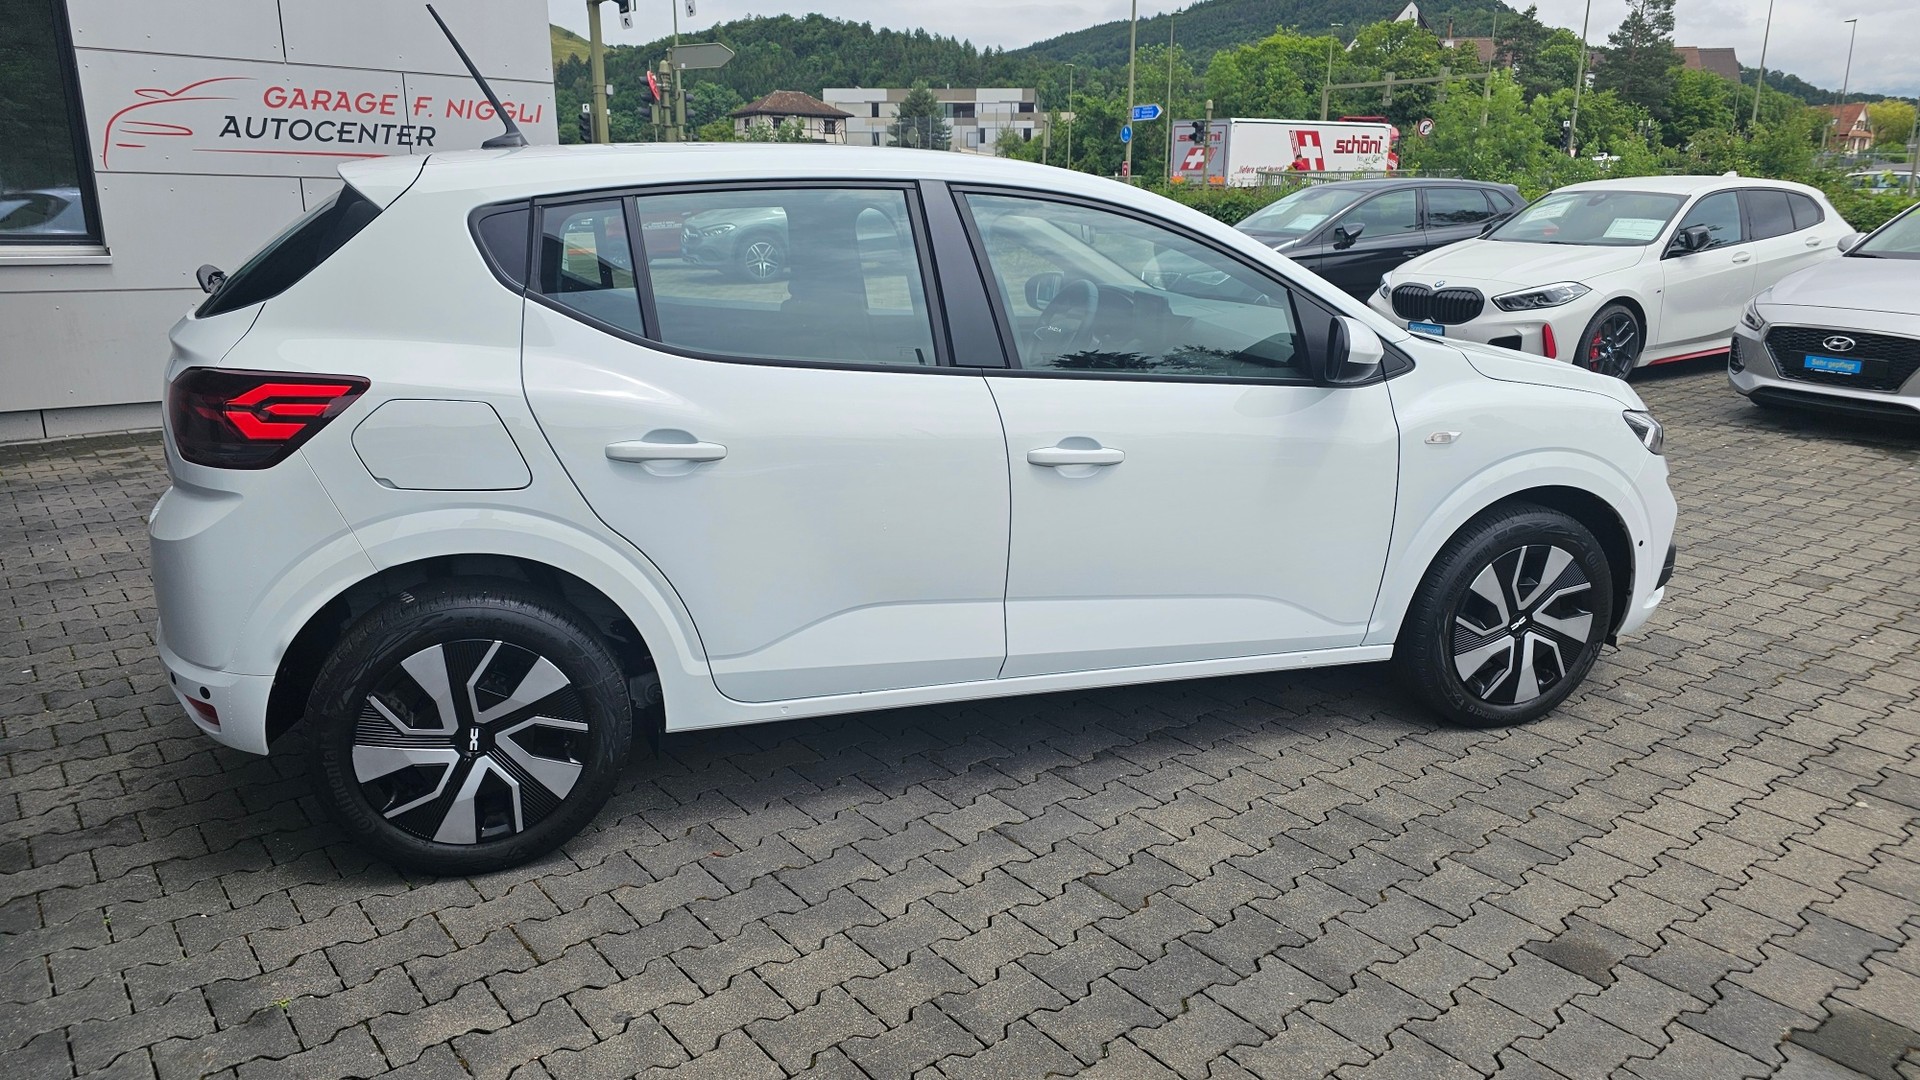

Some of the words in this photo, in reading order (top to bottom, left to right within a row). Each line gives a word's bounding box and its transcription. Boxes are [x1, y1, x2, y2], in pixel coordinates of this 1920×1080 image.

[263, 86, 398, 115] GARAGE
[413, 96, 432, 118] F.
[446, 98, 543, 123] NIGGLI
[219, 115, 437, 147] AUTOCENTER
